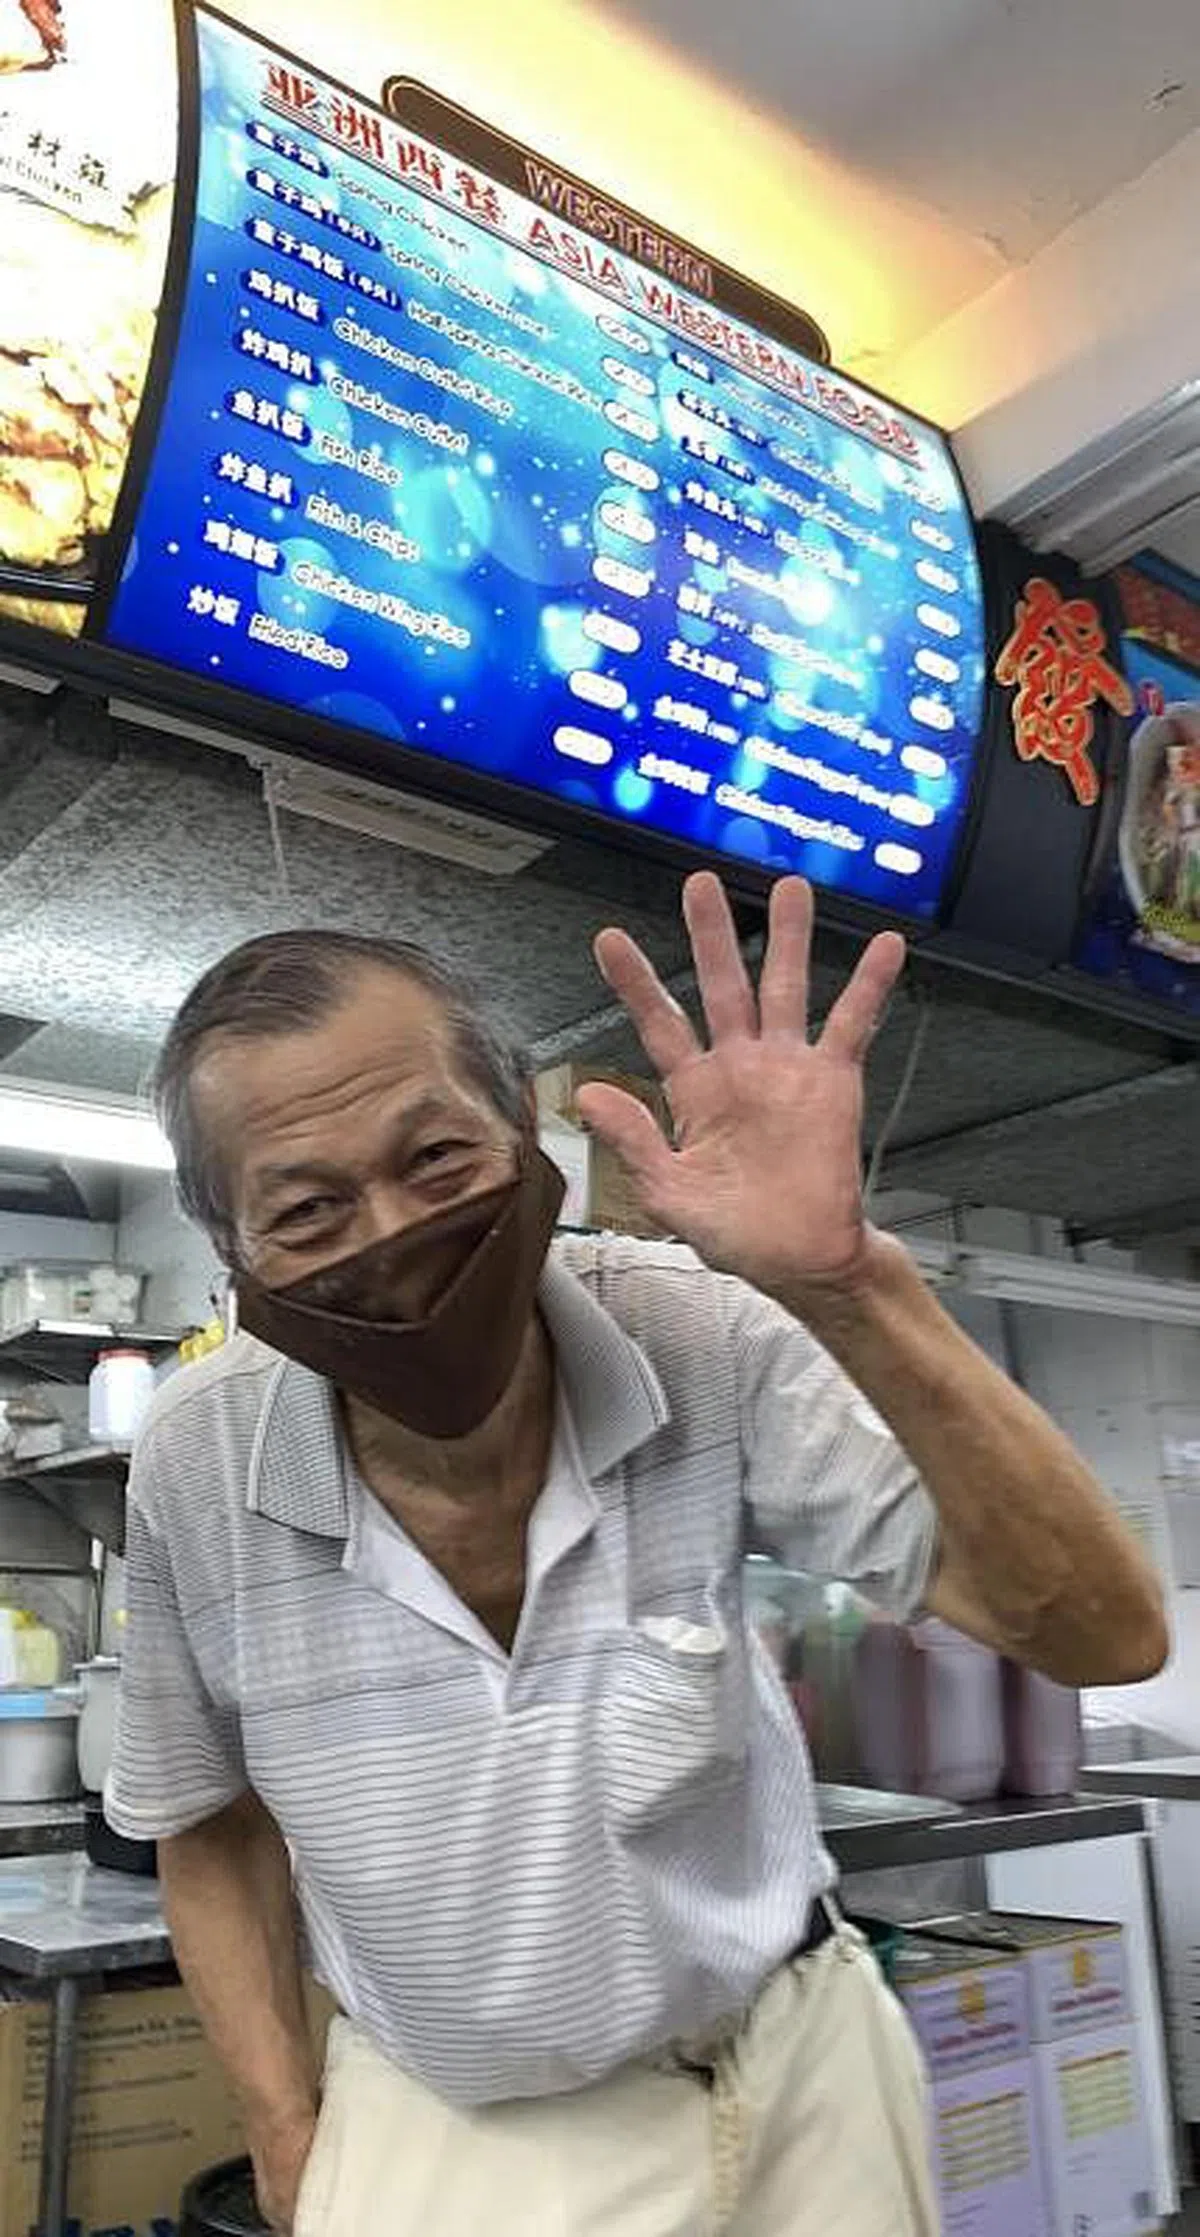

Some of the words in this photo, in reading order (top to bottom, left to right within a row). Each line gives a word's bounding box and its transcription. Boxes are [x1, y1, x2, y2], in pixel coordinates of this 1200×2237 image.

[525, 160, 717, 299] WESTERN
[527, 216, 632, 300] ASIA
[640, 280, 809, 398] WESTERN
[813, 375, 921, 456] FOOD
[327, 374, 412, 430] Chicken
[319, 433, 356, 467] Fish
[356, 448, 403, 487] Rice
[305, 494, 347, 528] Fish
[346, 512, 363, 539] &
[362, 519, 421, 562] Chips
[292, 559, 379, 613] Chicken
[304, 633, 349, 670] Rice
